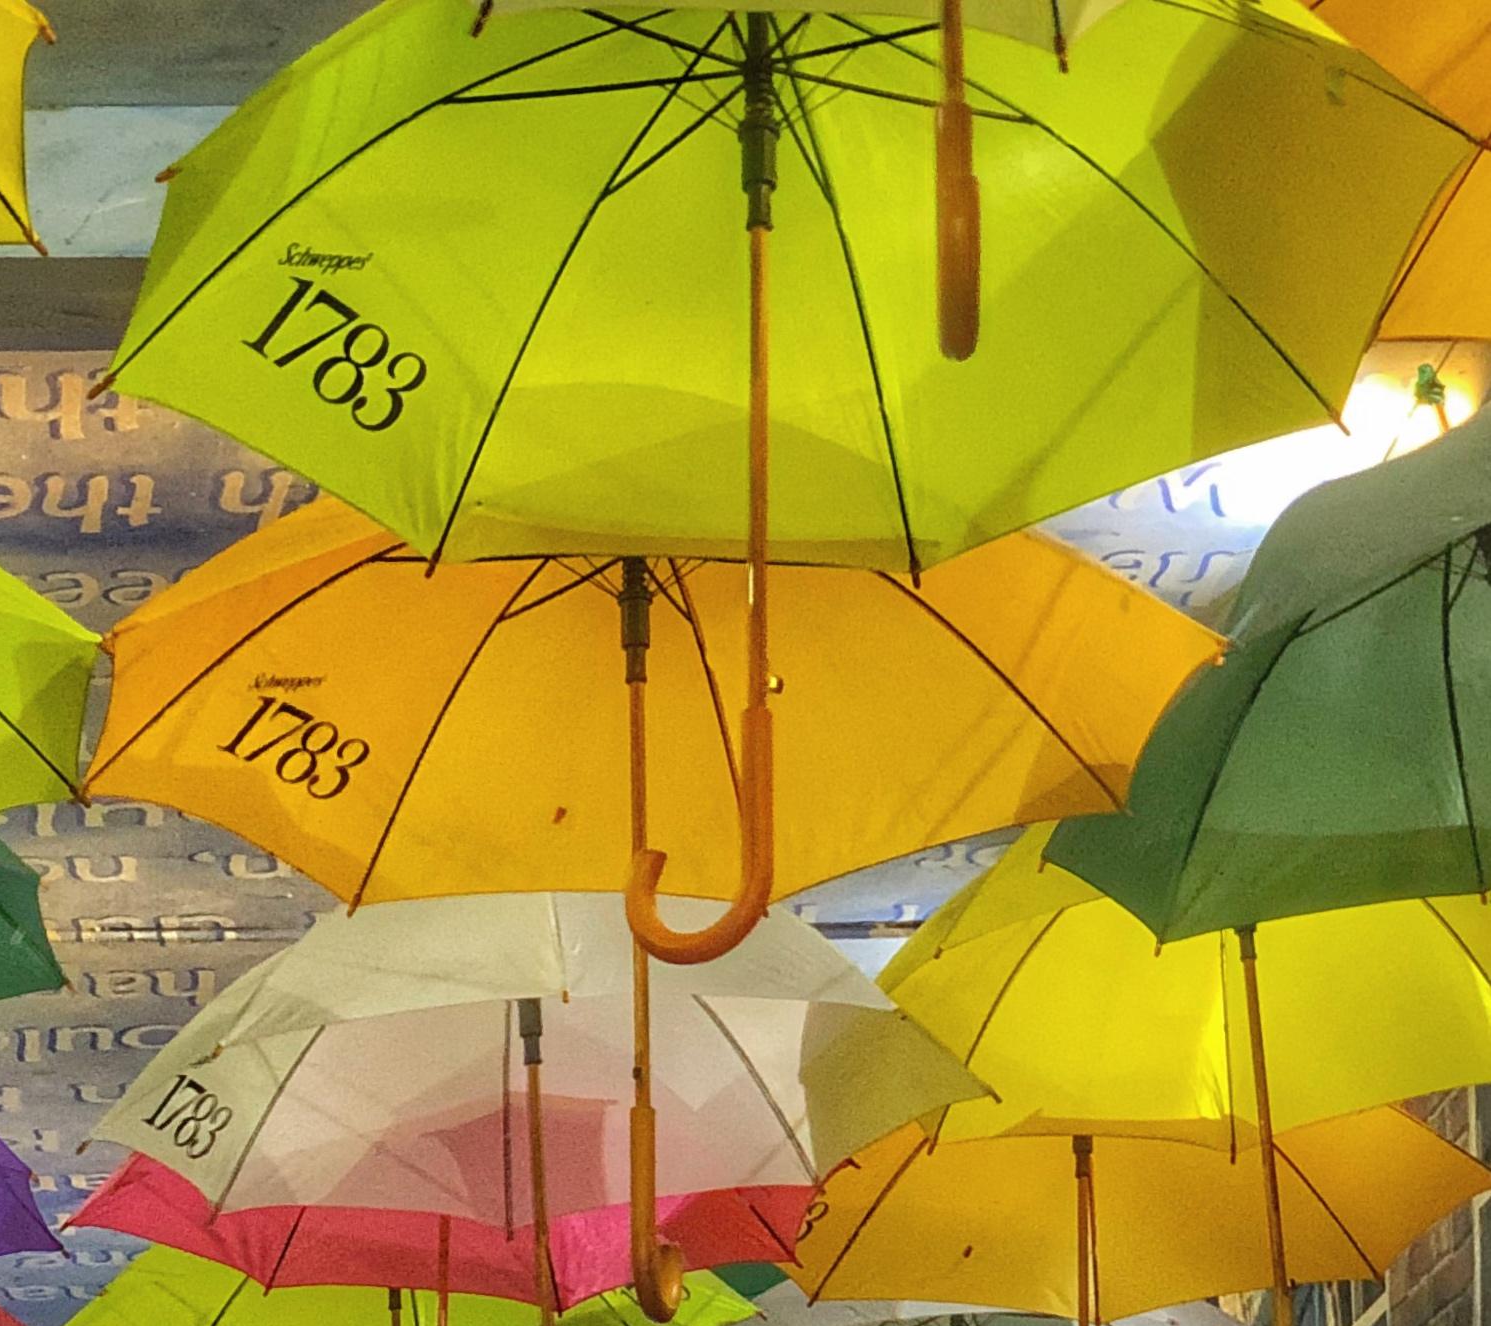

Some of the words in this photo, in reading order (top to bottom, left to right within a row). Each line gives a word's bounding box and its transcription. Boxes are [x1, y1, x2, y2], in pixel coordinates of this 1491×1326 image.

[241, 276, 427, 432] 1783
[216, 696, 371, 800] 1783
[140, 1074, 233, 1160] 1783
